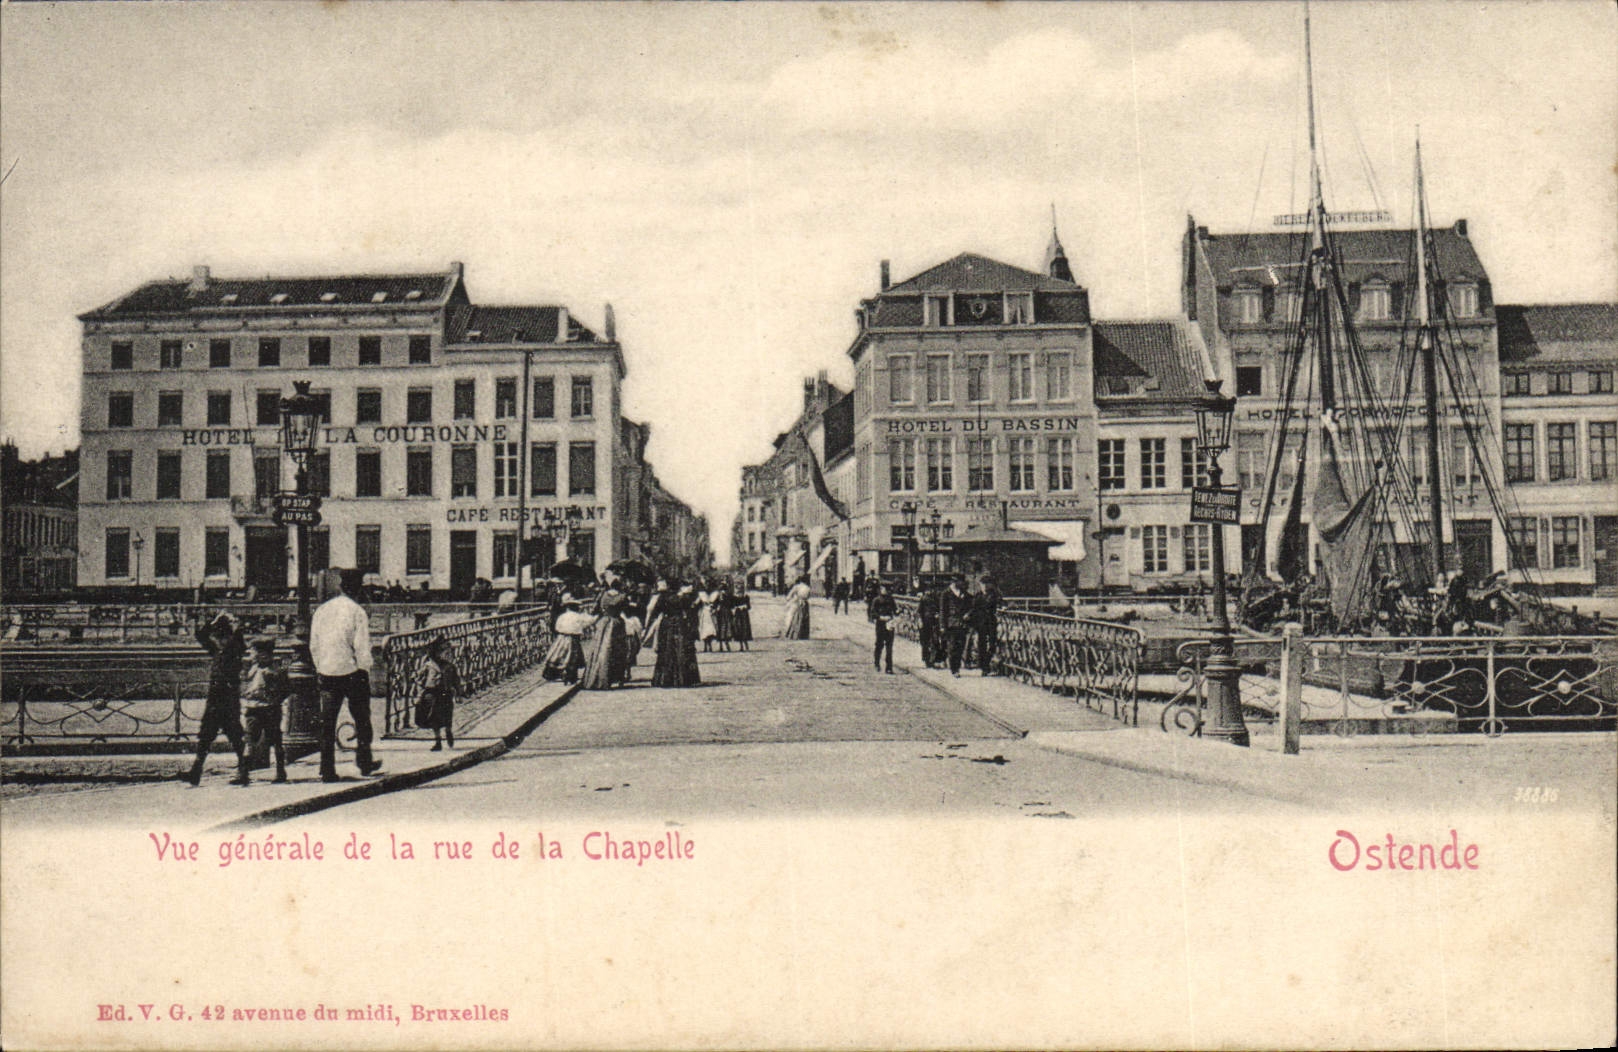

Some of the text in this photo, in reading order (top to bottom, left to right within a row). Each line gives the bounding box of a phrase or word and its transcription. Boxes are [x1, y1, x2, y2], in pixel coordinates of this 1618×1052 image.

[1332, 404, 1475, 421] COSMOPOITE
[888, 418, 1080, 433] HOTEL DU BASSIN
[182, 428, 256, 445] HOTEL
[325, 428, 358, 443] LA
[373, 424, 507, 443] COURONNE
[965, 499, 1080, 510] RESAURANT
[281, 512, 313, 521] AU PAS
[446, 505, 489, 523] CAFÉ
